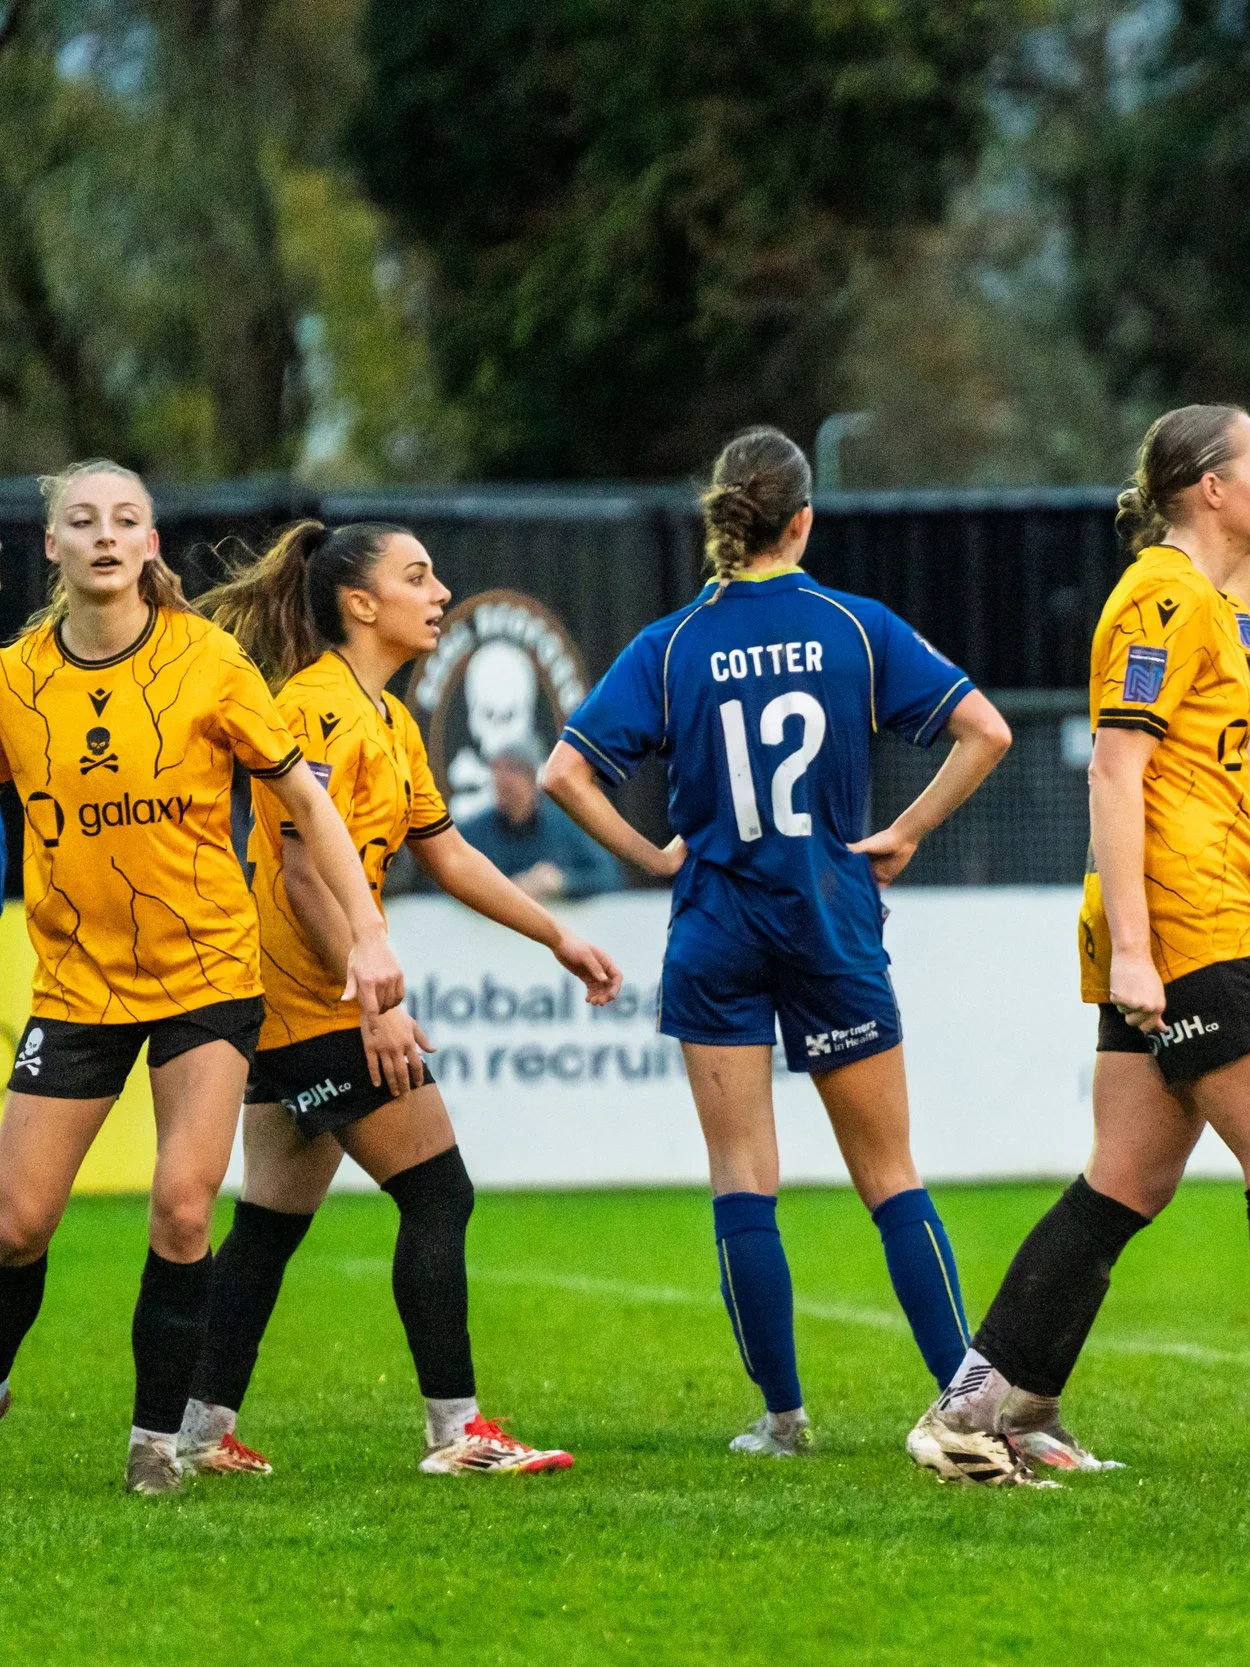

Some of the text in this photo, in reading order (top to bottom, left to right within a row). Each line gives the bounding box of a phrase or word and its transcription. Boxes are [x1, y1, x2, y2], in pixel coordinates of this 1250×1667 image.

[710, 640, 824, 682] COTTER
[719, 691, 827, 843] 12
[78, 792, 193, 837] galaxy
[404, 972, 574, 1026] lobal
[831, 1020, 877, 1042] Partners
[845, 1030, 880, 1049] Health
[488, 1041, 687, 1081] recrui
